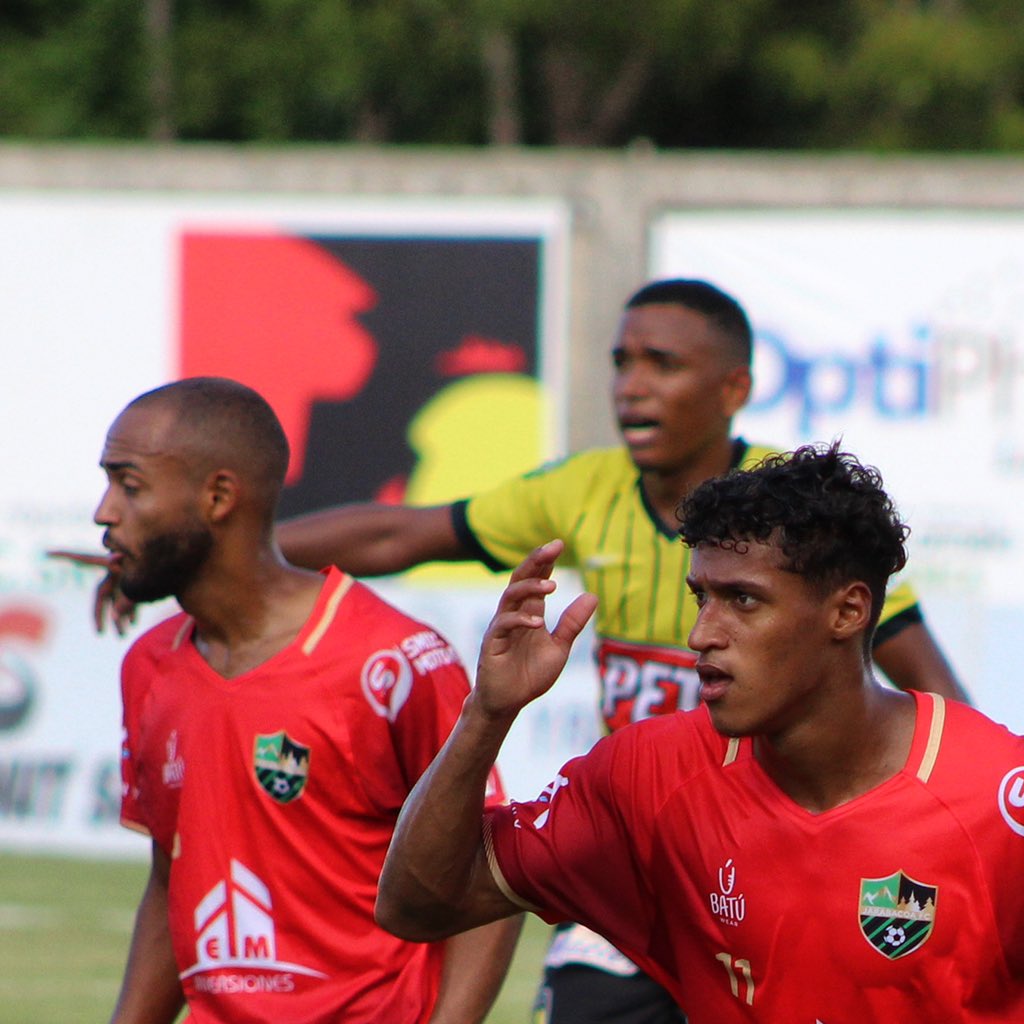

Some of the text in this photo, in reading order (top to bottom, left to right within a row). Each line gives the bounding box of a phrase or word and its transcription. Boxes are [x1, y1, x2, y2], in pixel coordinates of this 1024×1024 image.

[603, 655, 700, 723] PET
[709, 893, 745, 921] BATÚ
[715, 952, 755, 1006] 11
